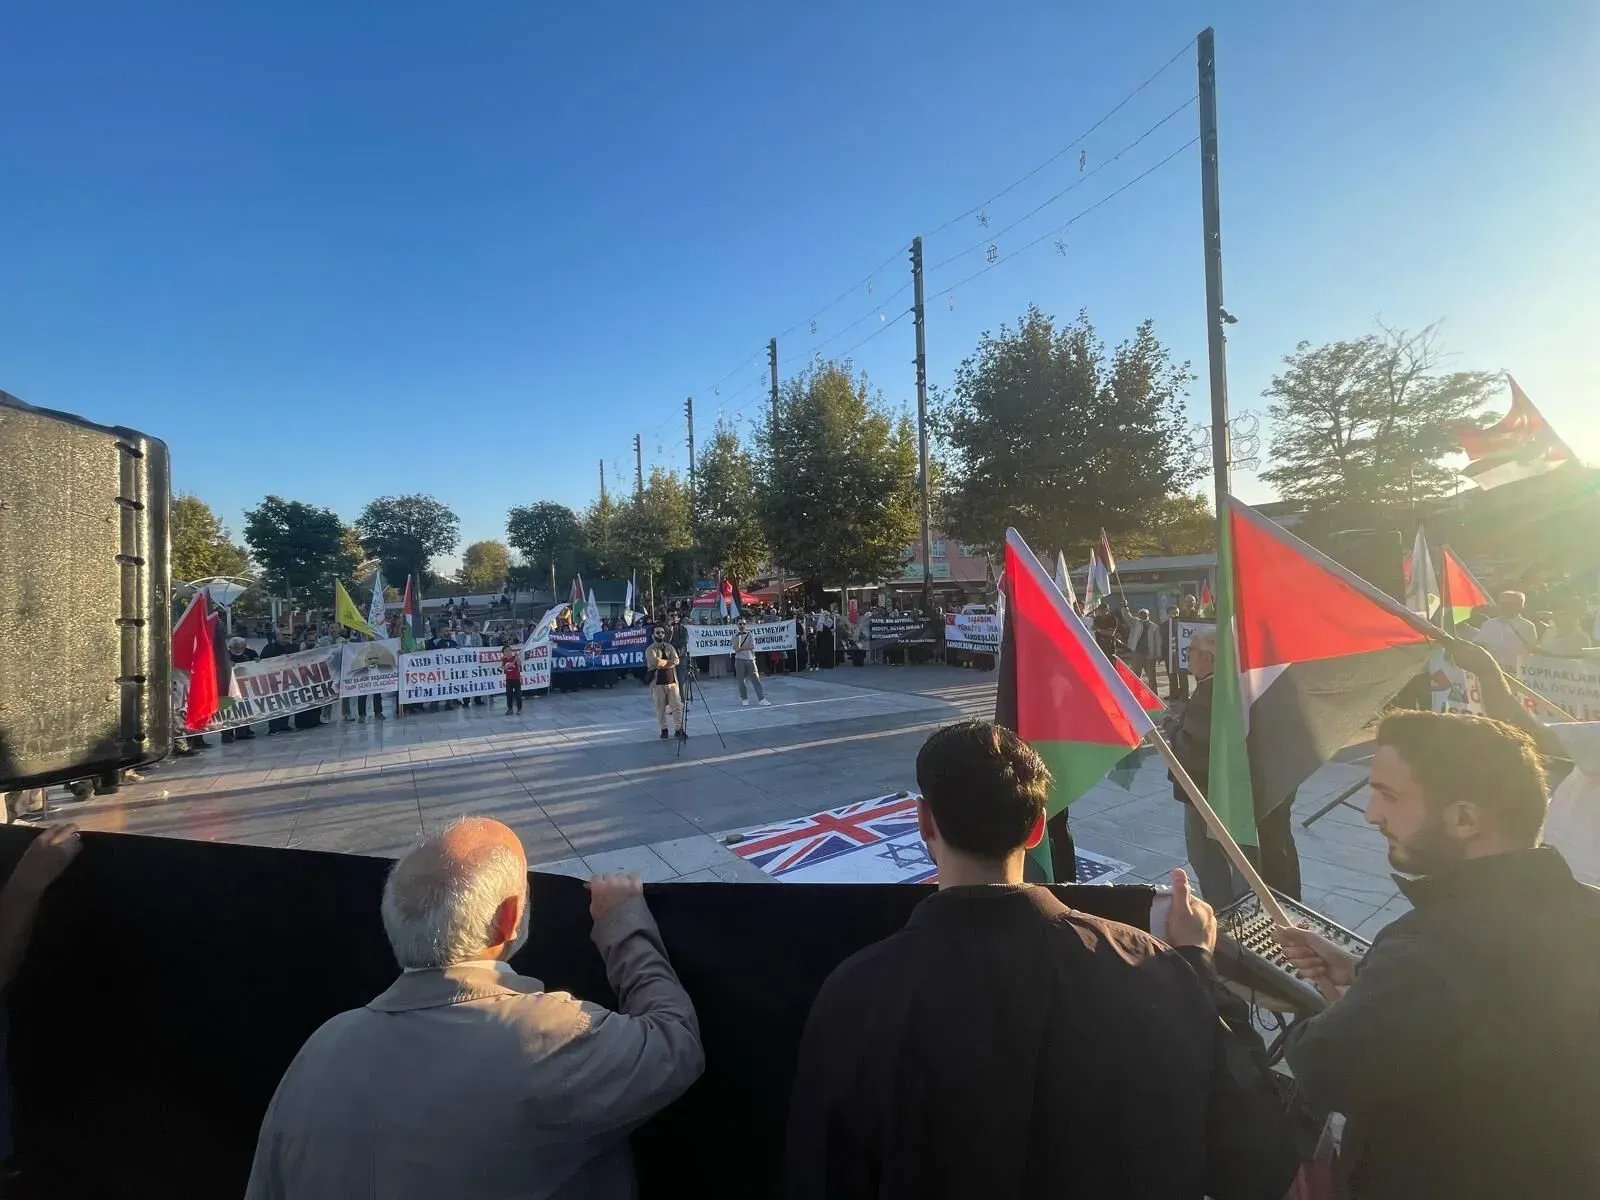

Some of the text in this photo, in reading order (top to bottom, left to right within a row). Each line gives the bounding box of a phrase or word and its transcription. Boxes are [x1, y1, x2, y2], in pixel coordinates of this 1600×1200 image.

[695, 640, 718, 648] YOKSA
[435, 651, 477, 665] ÜSLERİ
[601, 651, 644, 666] HAYIR
[405, 668, 449, 685] İSRAİL
[450, 668, 469, 680] İLE
[471, 665, 505, 678] SİYAS
[256, 680, 339, 714] YENECEK
[405, 687, 433, 699] TÜM
